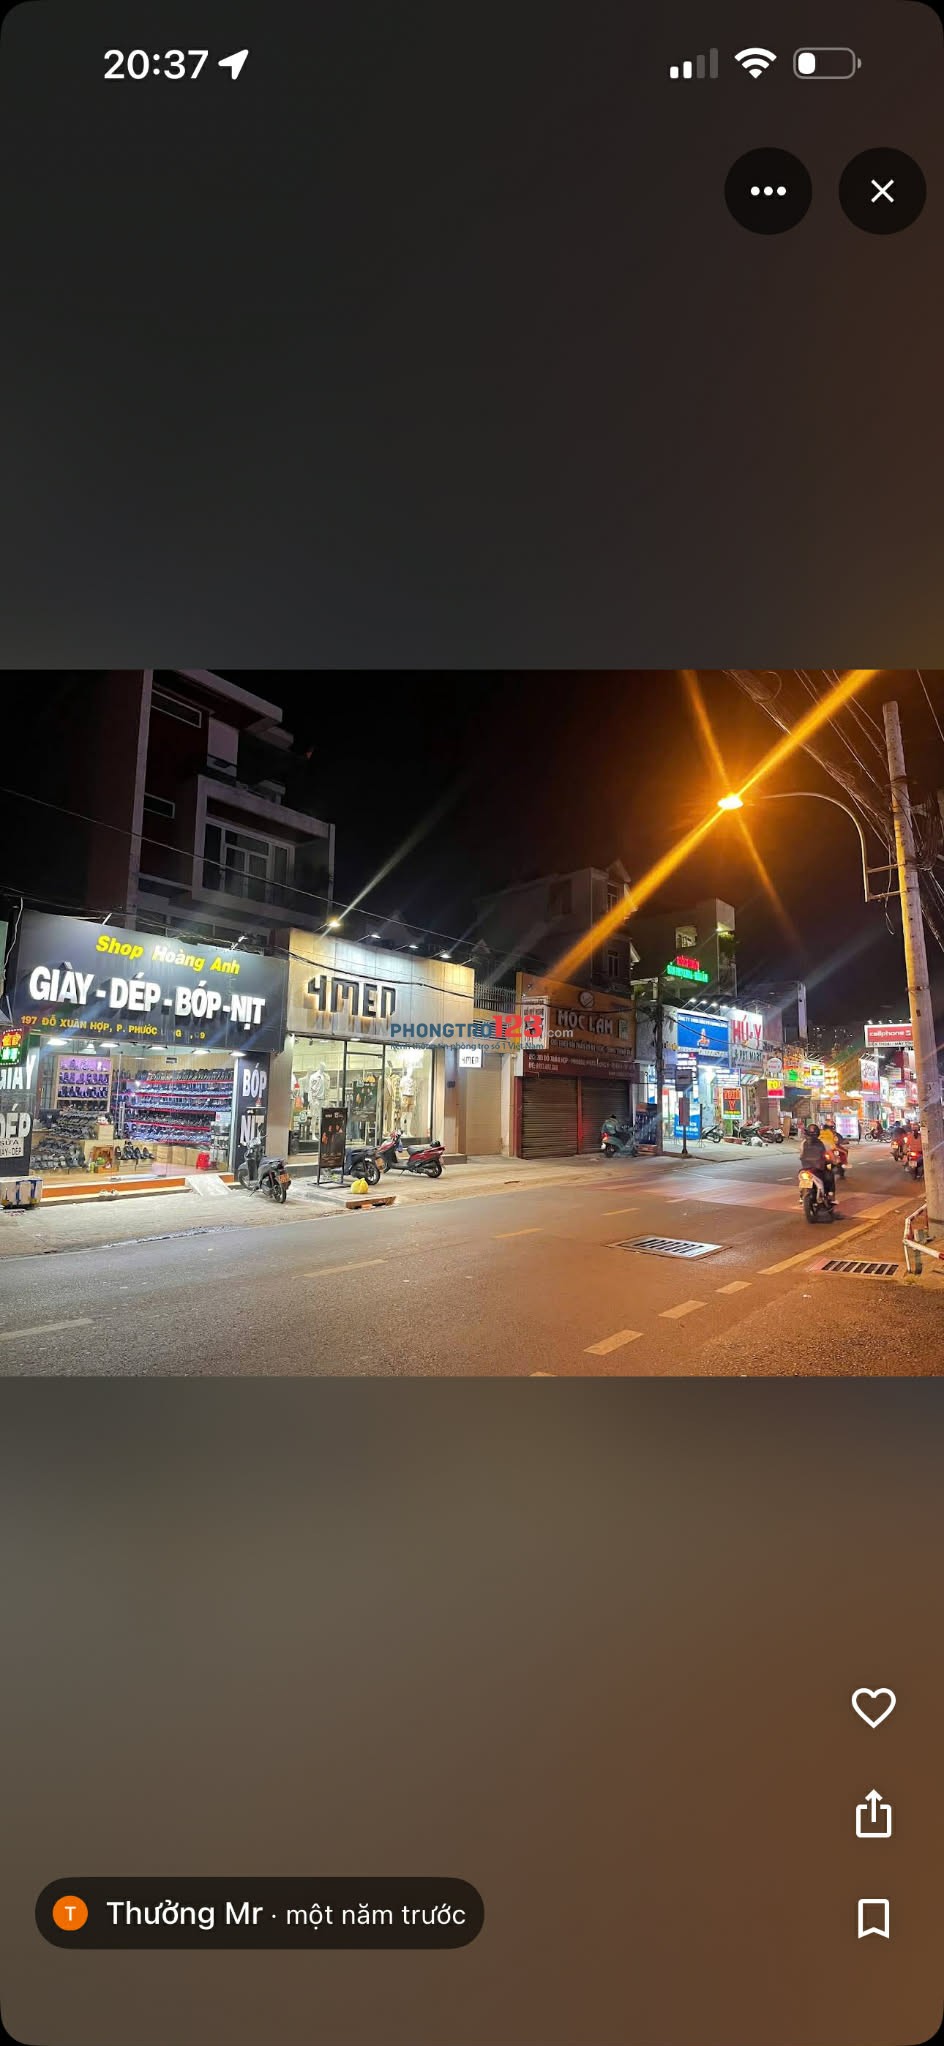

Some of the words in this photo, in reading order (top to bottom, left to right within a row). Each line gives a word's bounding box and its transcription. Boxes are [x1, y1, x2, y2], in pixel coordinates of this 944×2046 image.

[95, 935, 144, 960] Shop
[152, 944, 205, 971] Hoàng
[210, 957, 241, 975] Anh
[29, 961, 95, 1006] GIÀY
[109, 971, 161, 1012] DÉP
[174, 980, 222, 1019] BÓP
[230, 994, 266, 1030] NỊT
[308, 974, 396, 1019] 4MEN
[20, 1015, 37, 1025] 197
[41, 1015, 57, 1027] ĐỖ
[59, 1018, 87, 1029] XUÂN
[90, 1021, 113, 1033] HỢP,
[116, 1024, 126, 1033] P.
[128, 1023, 158, 1036] PHƯỚC
[242, 1062, 267, 1098] BÓP
